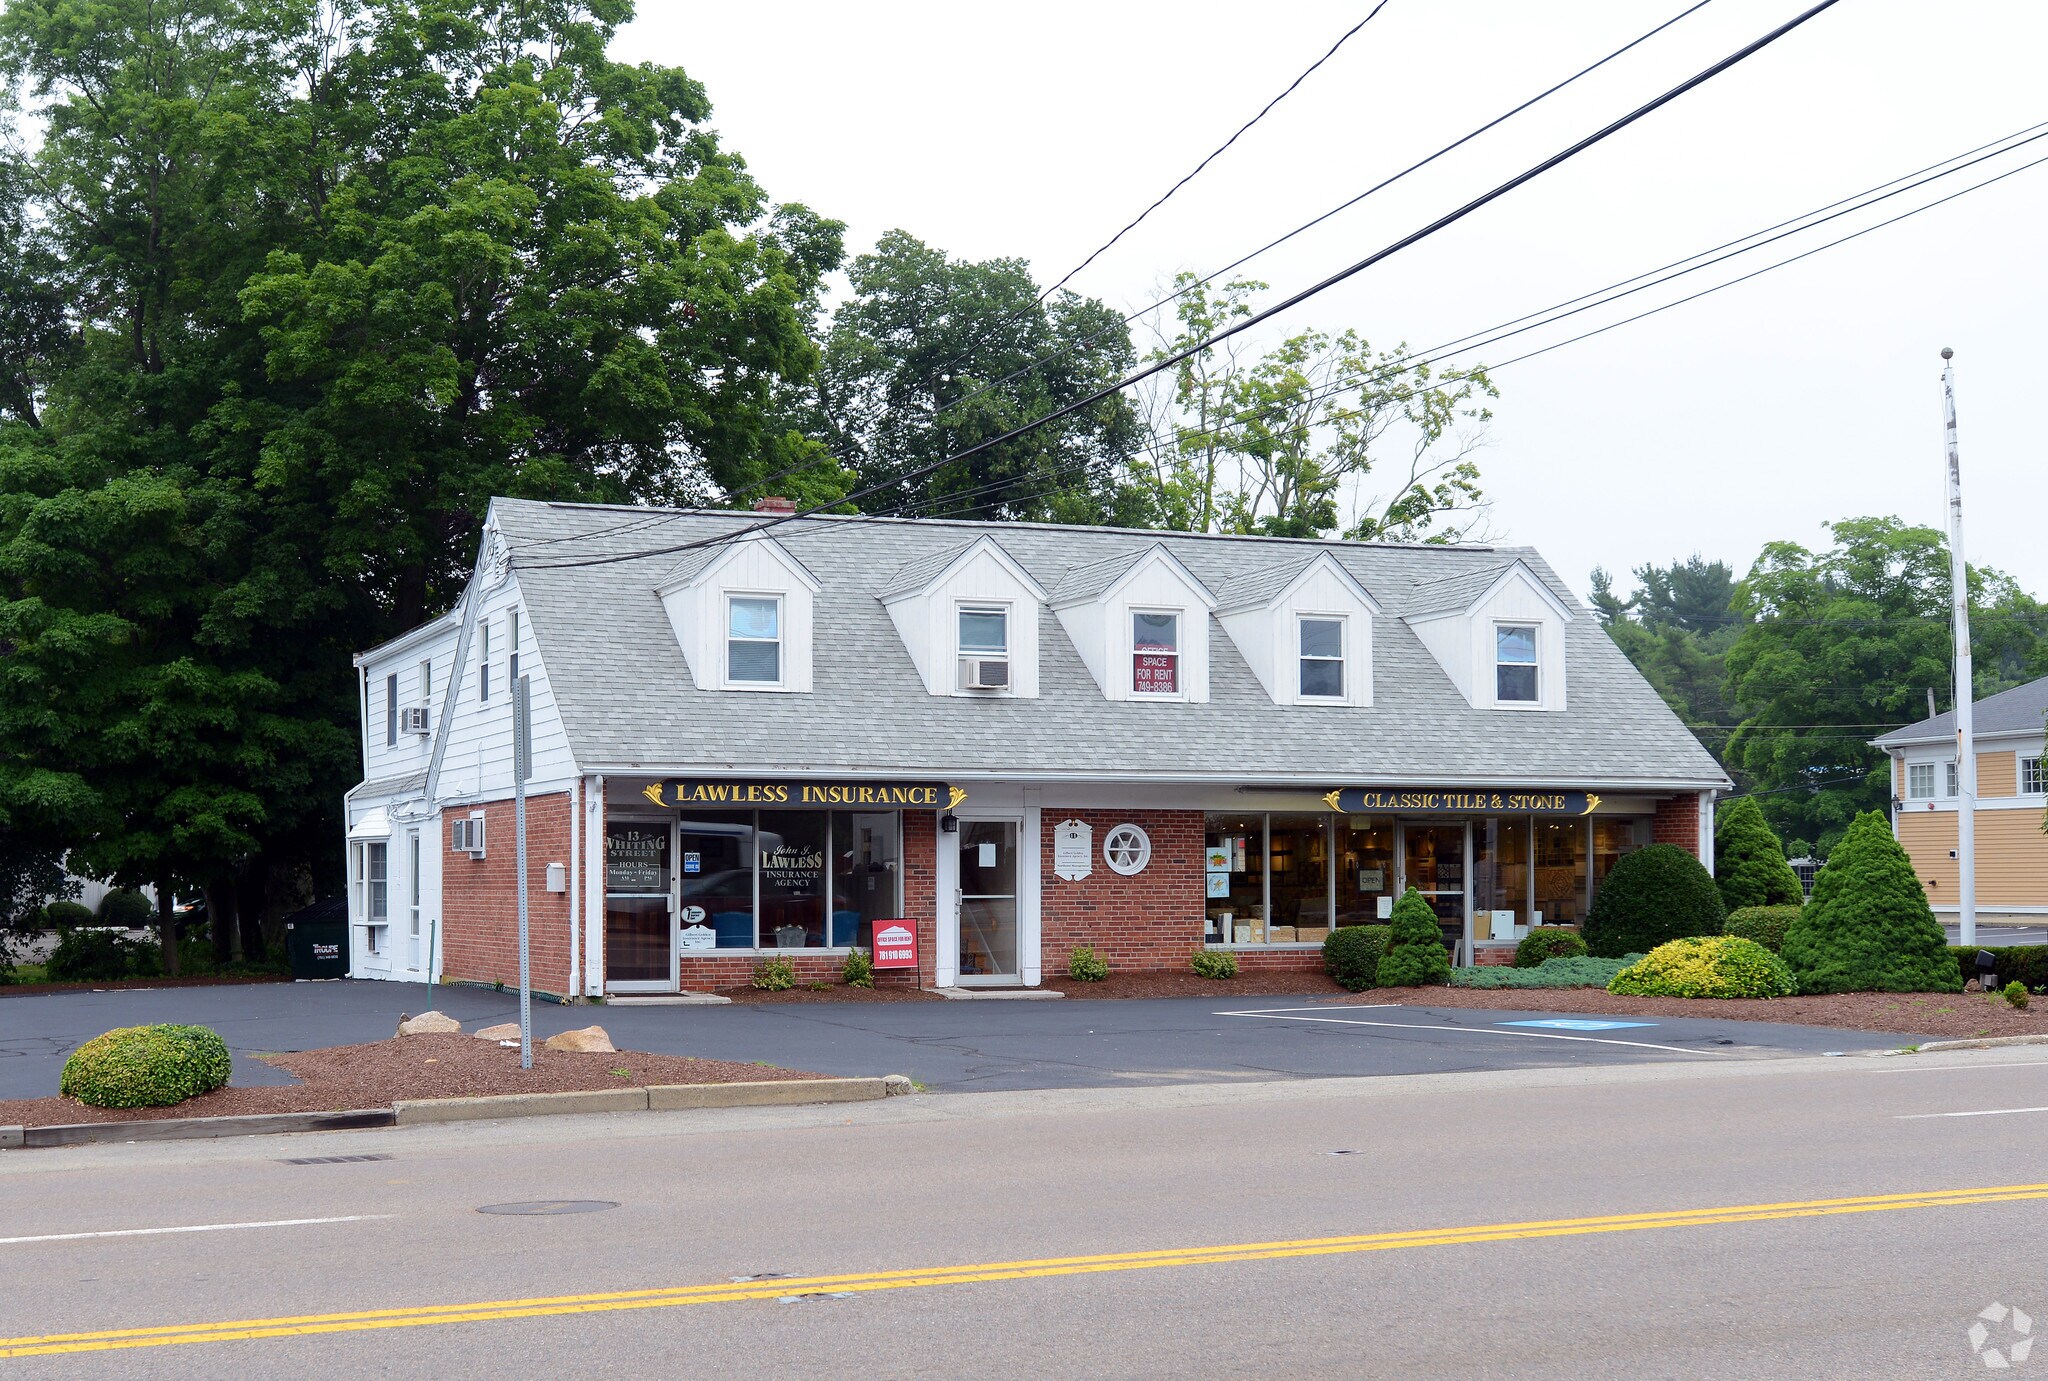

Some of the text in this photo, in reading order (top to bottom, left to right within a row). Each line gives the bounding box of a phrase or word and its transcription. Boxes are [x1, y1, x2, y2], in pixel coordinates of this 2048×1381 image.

[1143, 657, 1167, 666] SPACE
[1136, 669, 1173, 680] FOR RENT
[1137, 681, 1173, 692] 749-8386
[676, 784, 938, 804] LAWLESS INSURANCE
[1363, 793, 1565, 810] CLASSIC TILE & STONE
[627, 831, 639, 841] 13
[606, 836, 665, 850] WHITING
[773, 845, 798, 855] John
[762, 850, 822, 868] LAWLESS
[879, 951, 889, 960] 781
